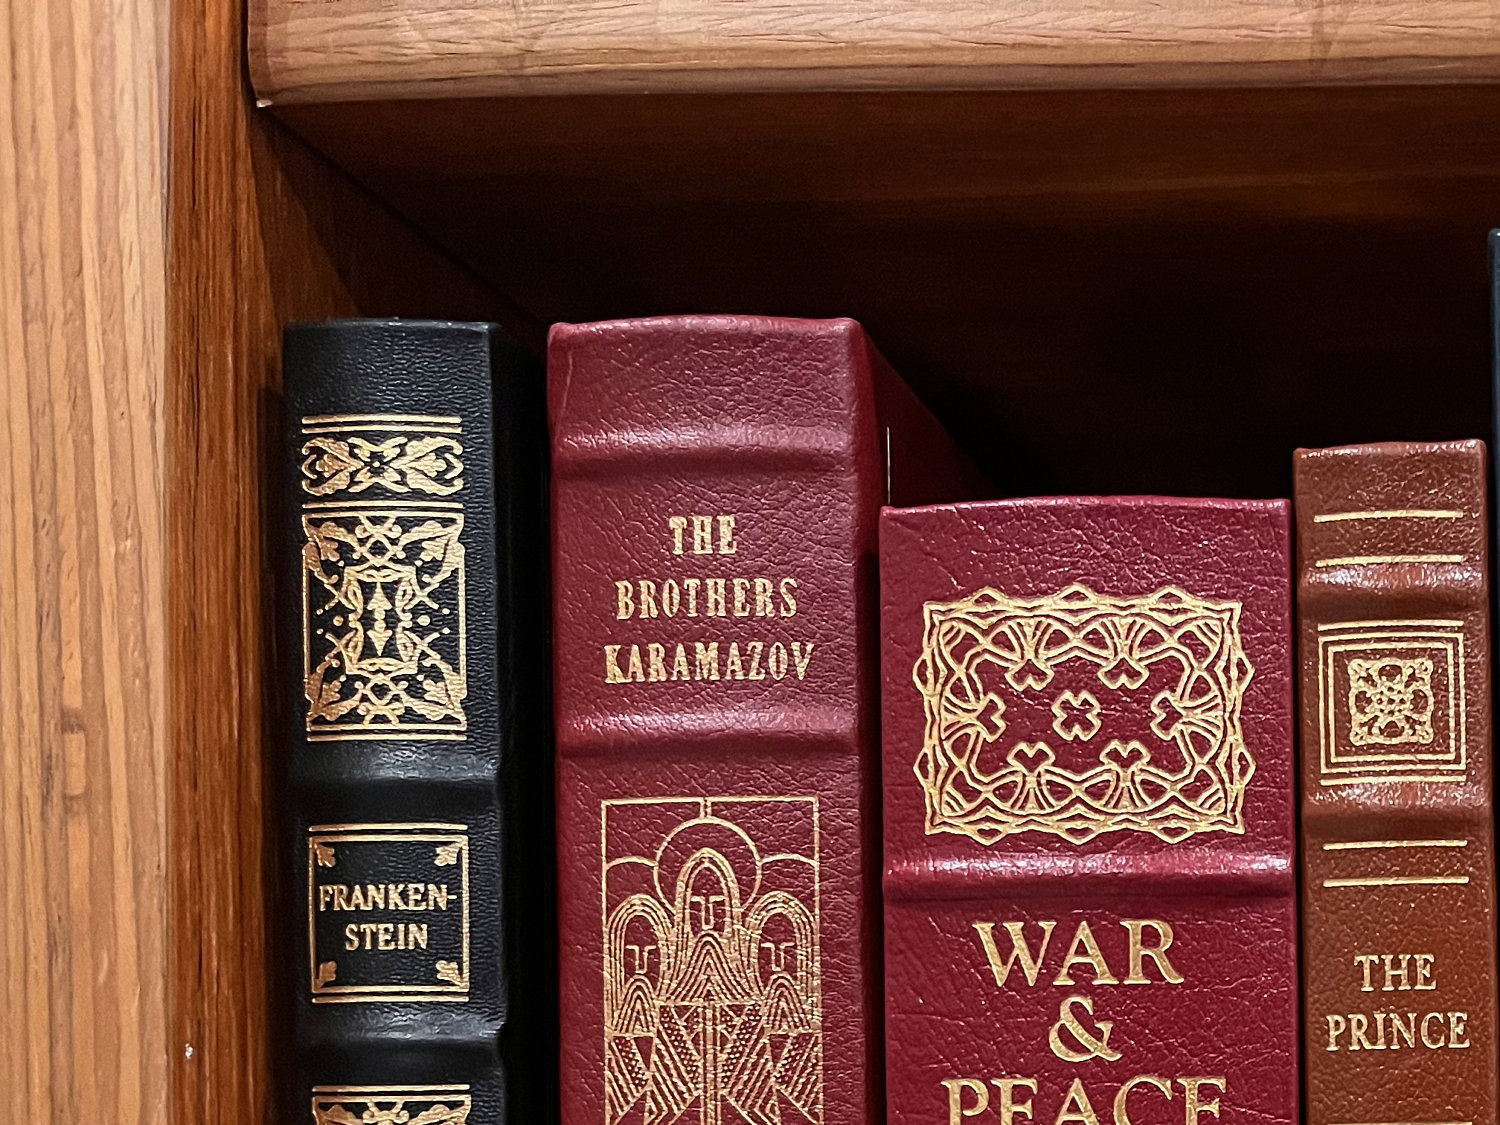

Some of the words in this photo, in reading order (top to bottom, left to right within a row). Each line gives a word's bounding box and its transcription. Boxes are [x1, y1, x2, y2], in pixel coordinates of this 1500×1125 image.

[668, 515, 738, 555] THE
[615, 577, 798, 620] BROTHERS
[604, 641, 815, 684] KARAMAZOV
[319, 883, 458, 912] FRANKEN-
[345, 923, 428, 951] STEIN
[971, 919, 1185, 988] WAR
[1353, 953, 1437, 992] THE
[1048, 995, 1123, 1063] &
[1326, 1011, 1471, 1051] PRINCE
